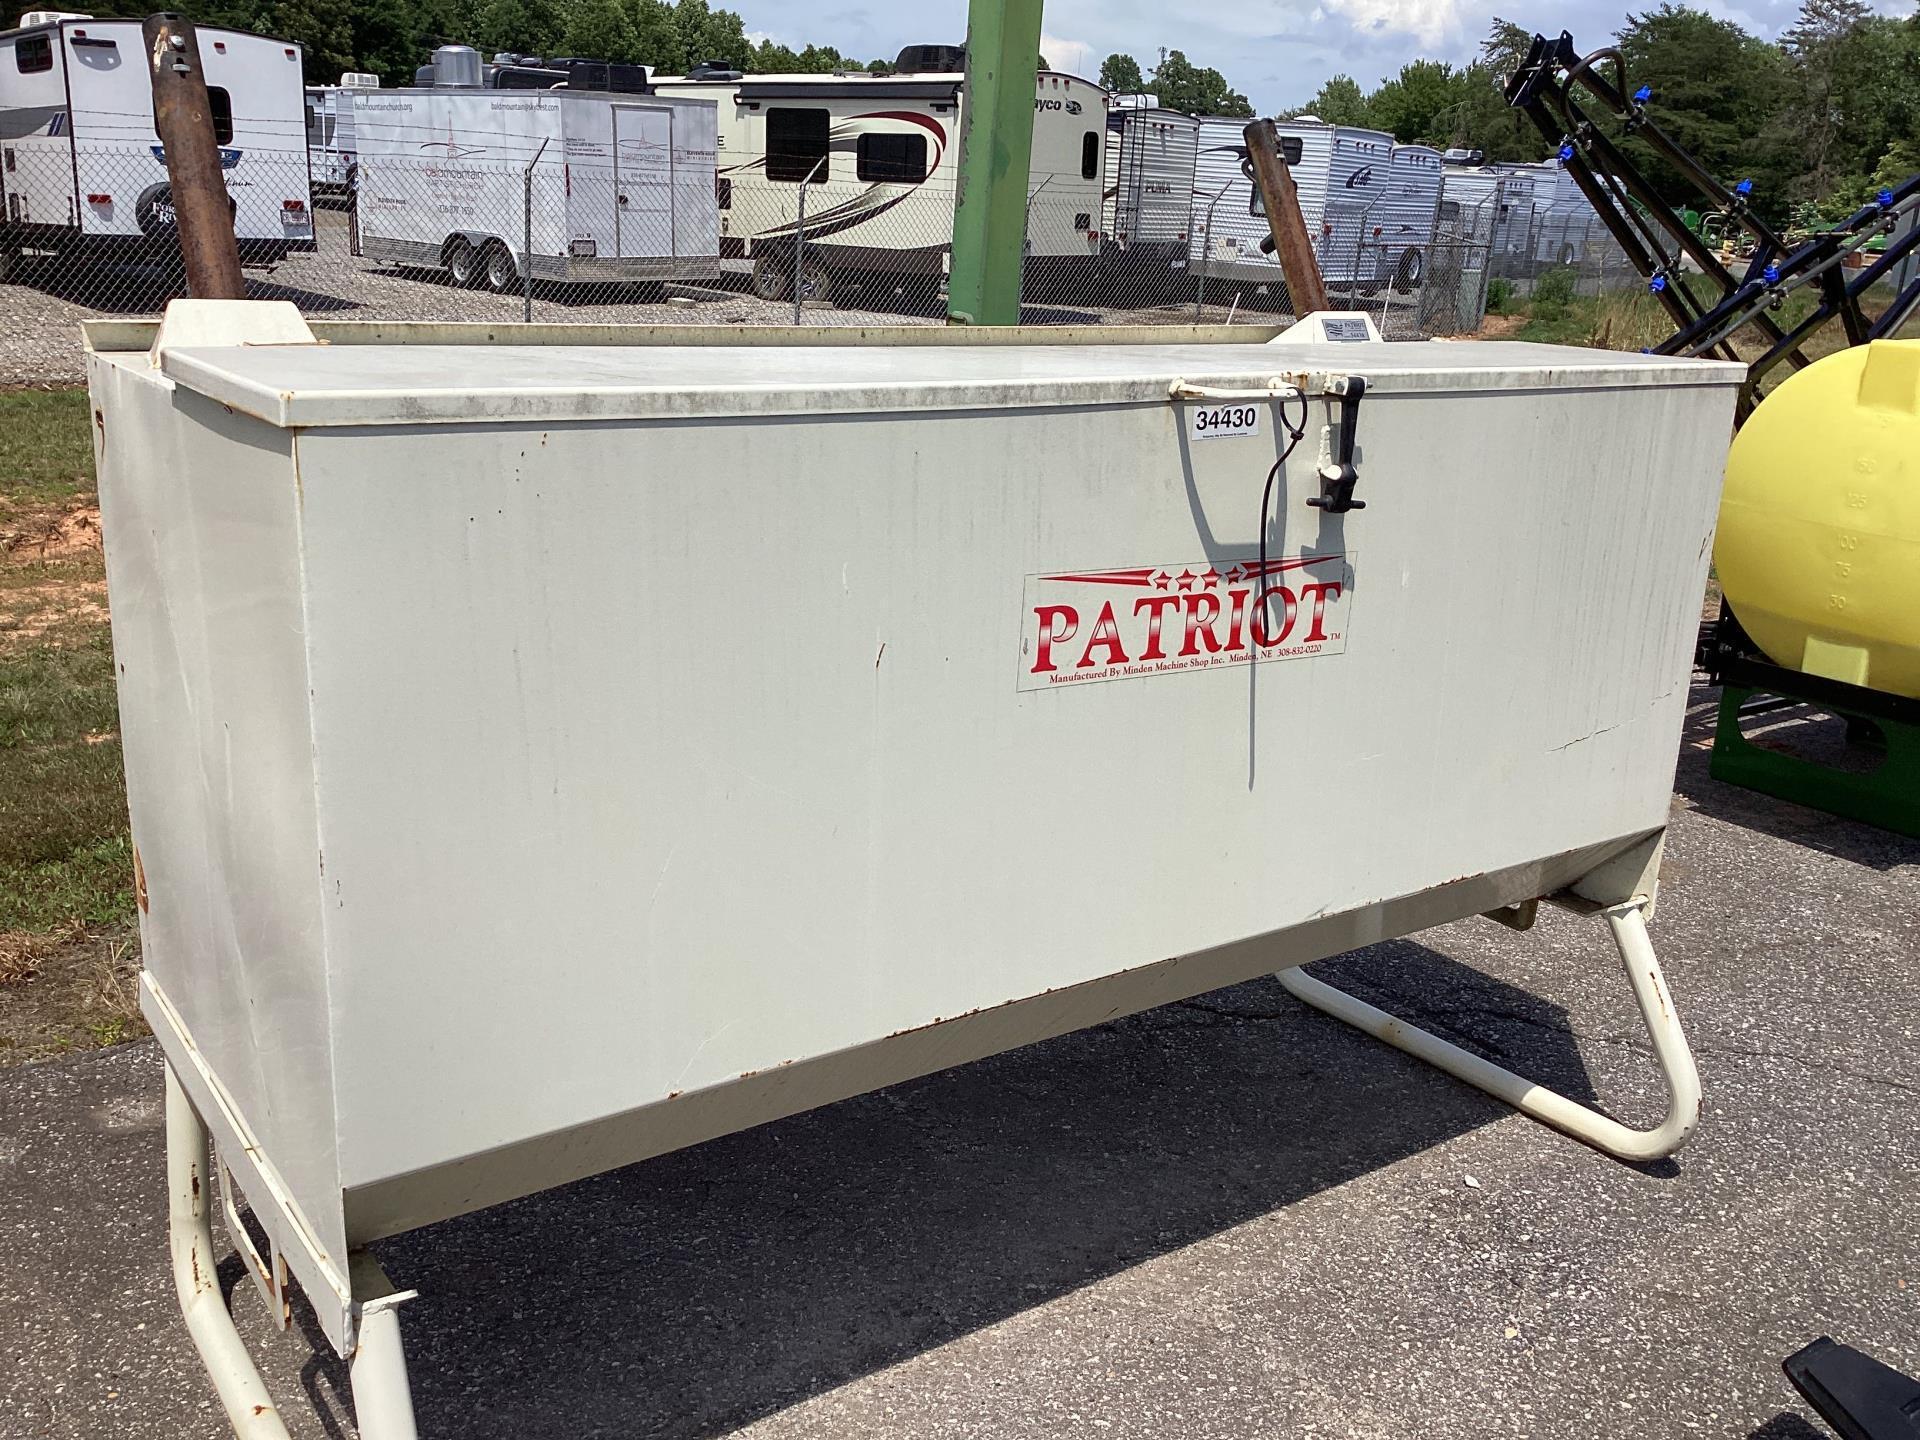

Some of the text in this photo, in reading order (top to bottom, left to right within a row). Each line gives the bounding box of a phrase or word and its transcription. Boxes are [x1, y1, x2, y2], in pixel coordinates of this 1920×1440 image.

[1034, 98, 1061, 112] ayco
[1196, 407, 1256, 431] 34430
[1835, 561, 1851, 577] 75
[1829, 594, 1846, 609] 50
[1030, 581, 1342, 673] PATRIOT
[1049, 644, 1322, 684] Manufactured By Minden Machine Shop Inc. Minden, NE 308-832-0220
